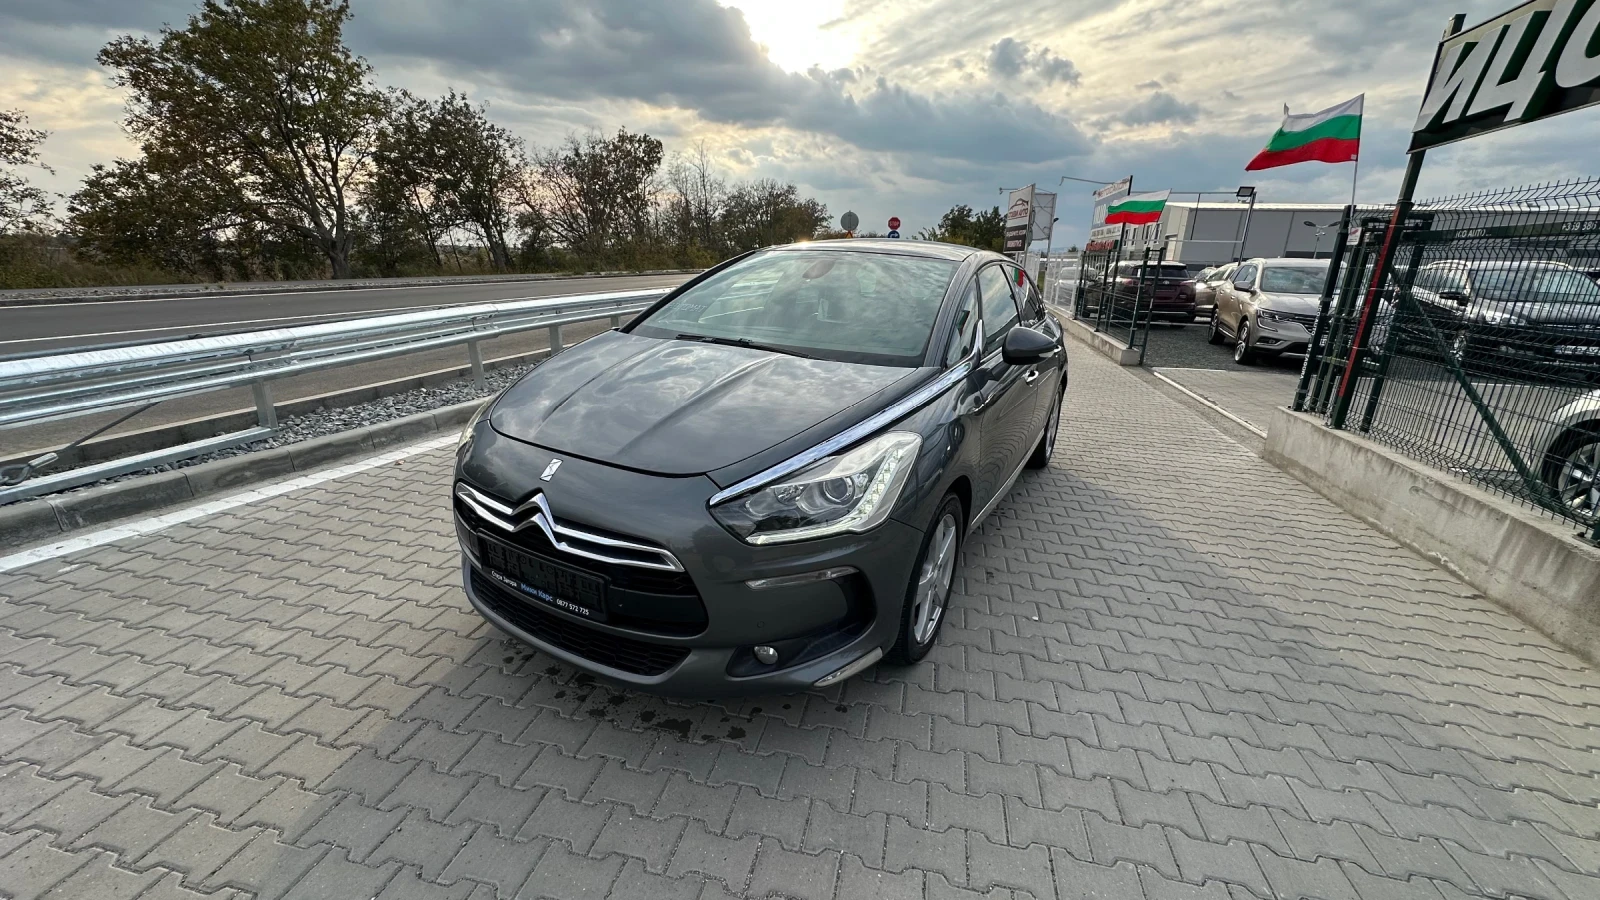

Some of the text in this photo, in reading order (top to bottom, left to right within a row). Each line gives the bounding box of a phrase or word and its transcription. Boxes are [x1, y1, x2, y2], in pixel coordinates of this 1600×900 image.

[491, 570, 503, 581] Стара
[503, 575, 517, 587] Загора
[538, 588, 553, 601] Карс
[556, 598, 569, 608] 0877
[569, 603, 579, 612] 572
[579, 606, 590, 616] 725
